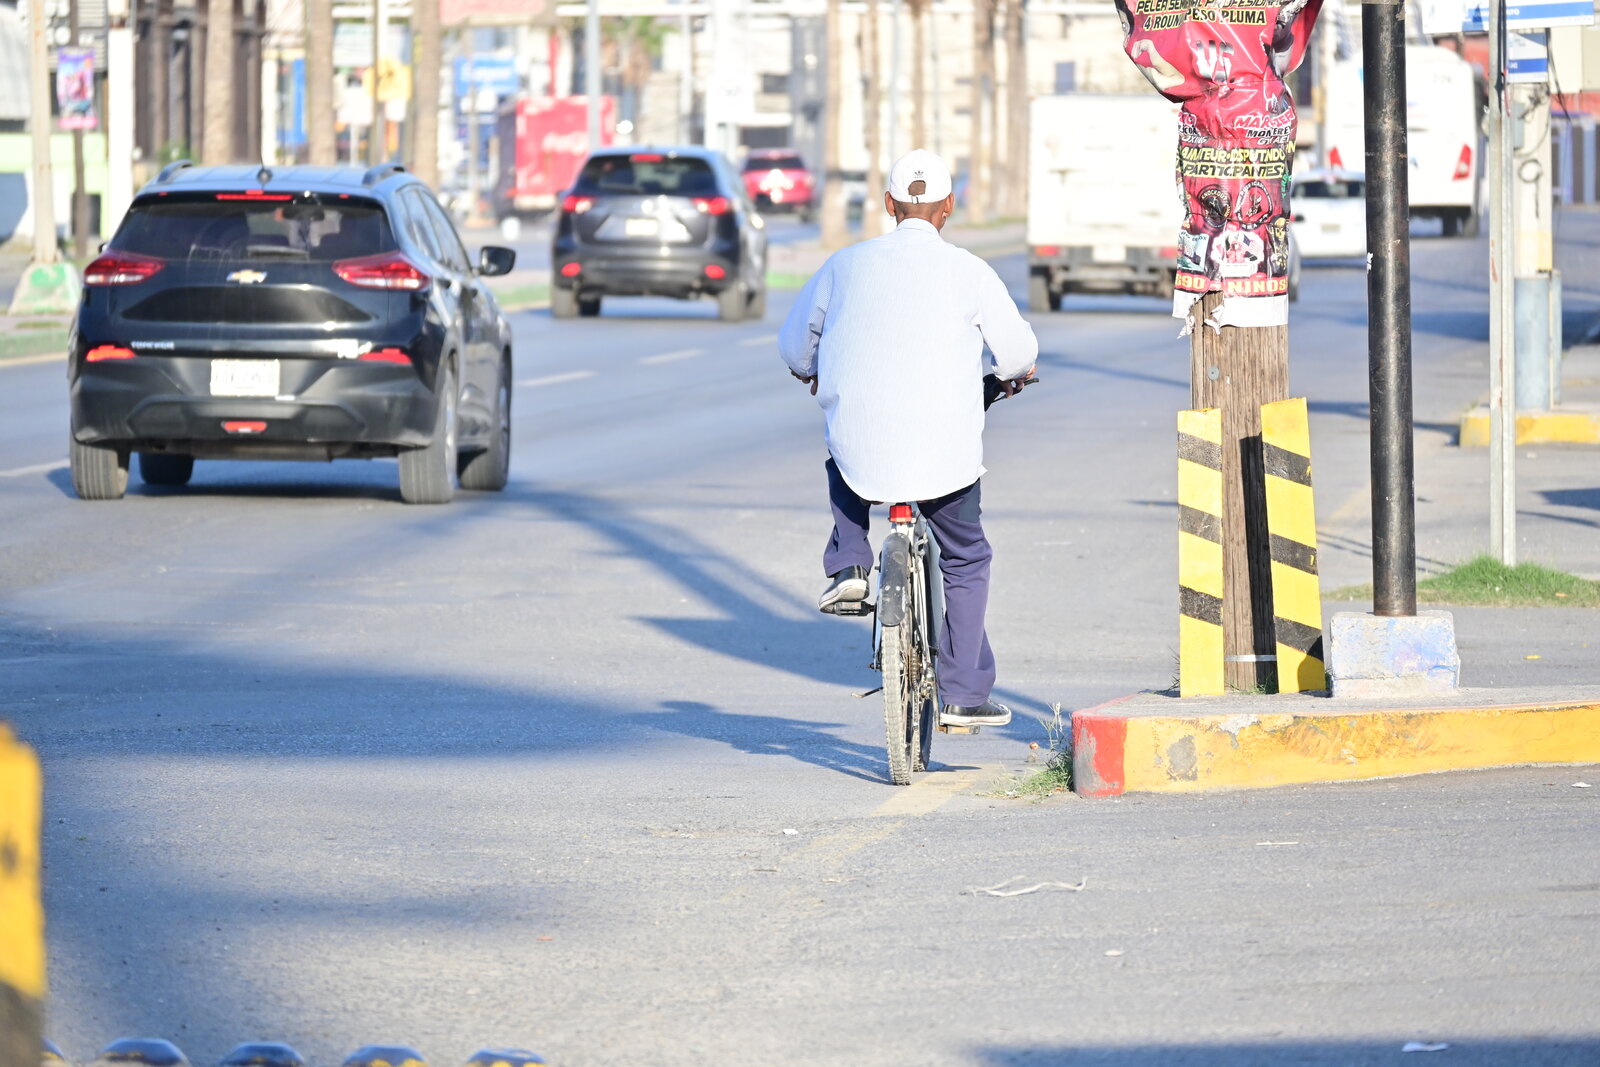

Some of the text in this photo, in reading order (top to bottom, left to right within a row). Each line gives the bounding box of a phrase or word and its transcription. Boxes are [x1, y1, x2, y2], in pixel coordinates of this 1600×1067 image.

[1144, 14, 1182, 30] 4 ROUN
[1184, 8, 1266, 24] PESO PLUMA
